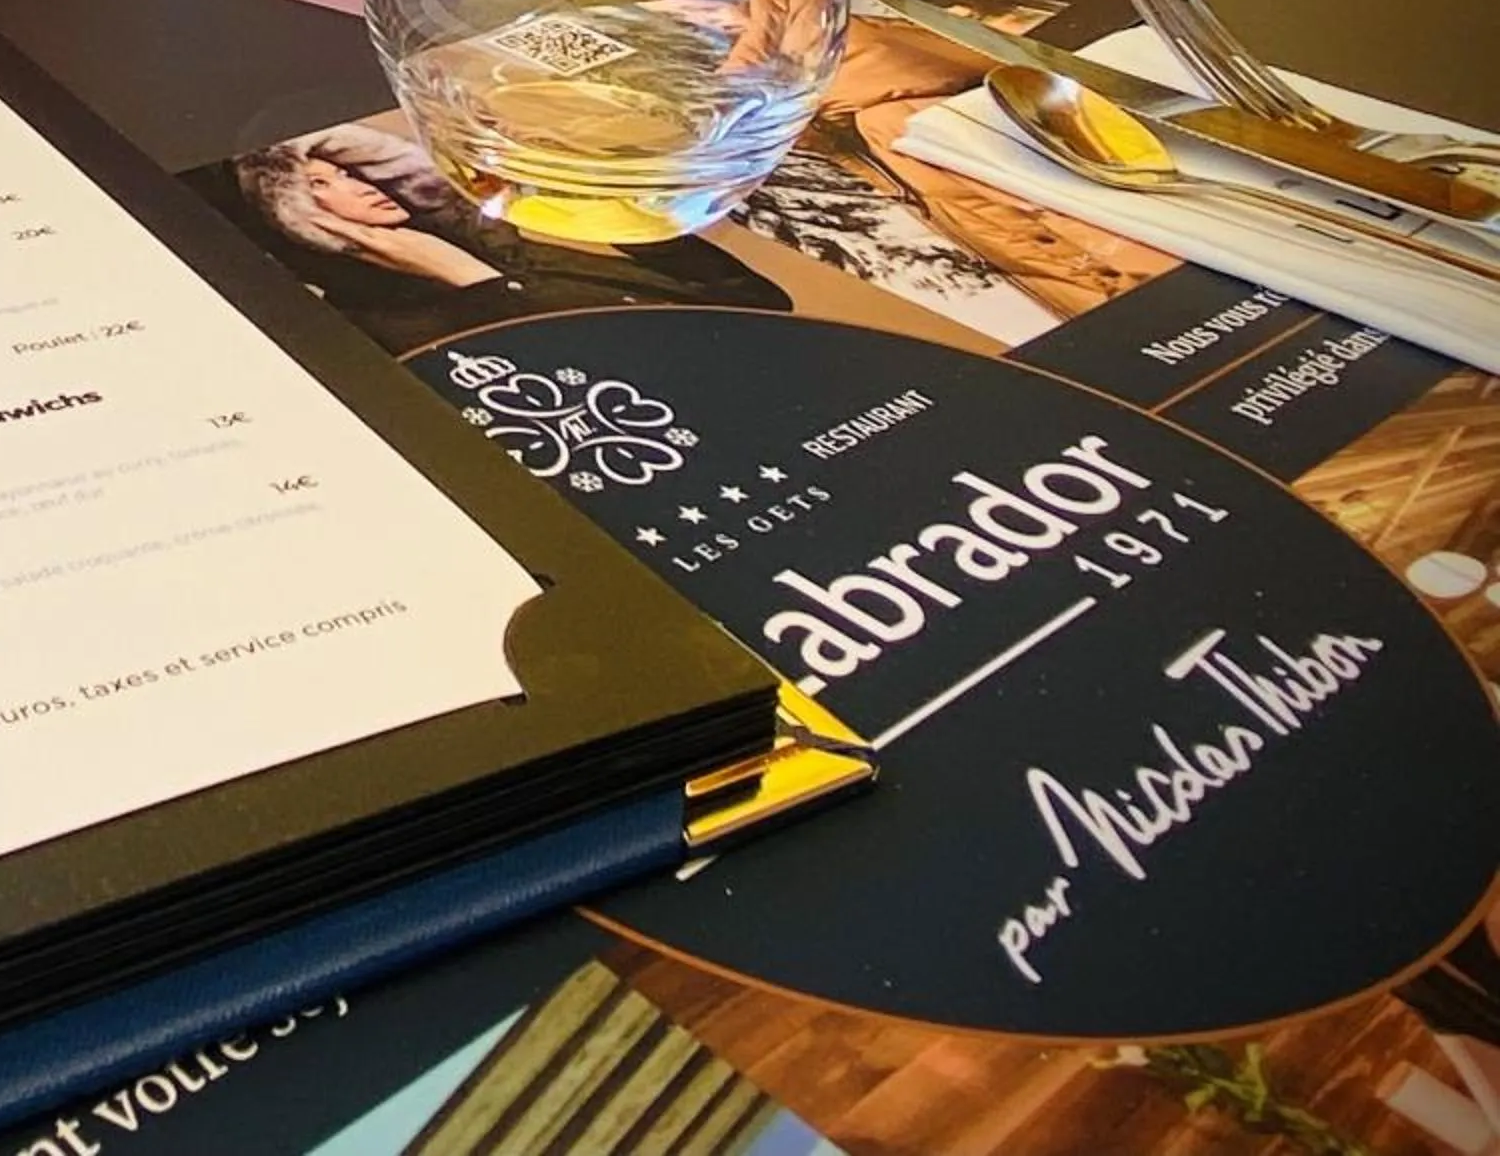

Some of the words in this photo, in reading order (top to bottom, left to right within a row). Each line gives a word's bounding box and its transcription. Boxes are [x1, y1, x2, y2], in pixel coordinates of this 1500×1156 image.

[11, 329, 88, 356] Poulet
[1141, 325, 1220, 366] Nous
[1213, 298, 1269, 335] vous
[802, 388, 936, 461] RESTAURANT
[1229, 347, 1348, 426] privilégié
[671, 532, 740, 573] LES
[763, 434, 1153, 697] abrador
[1074, 490, 1229, 589] 1971
[79, 665, 160, 703] taxes
[165, 655, 196, 678] et
[200, 625, 298, 669] service
[301, 596, 410, 644] compris
[997, 876, 1073, 984] par
